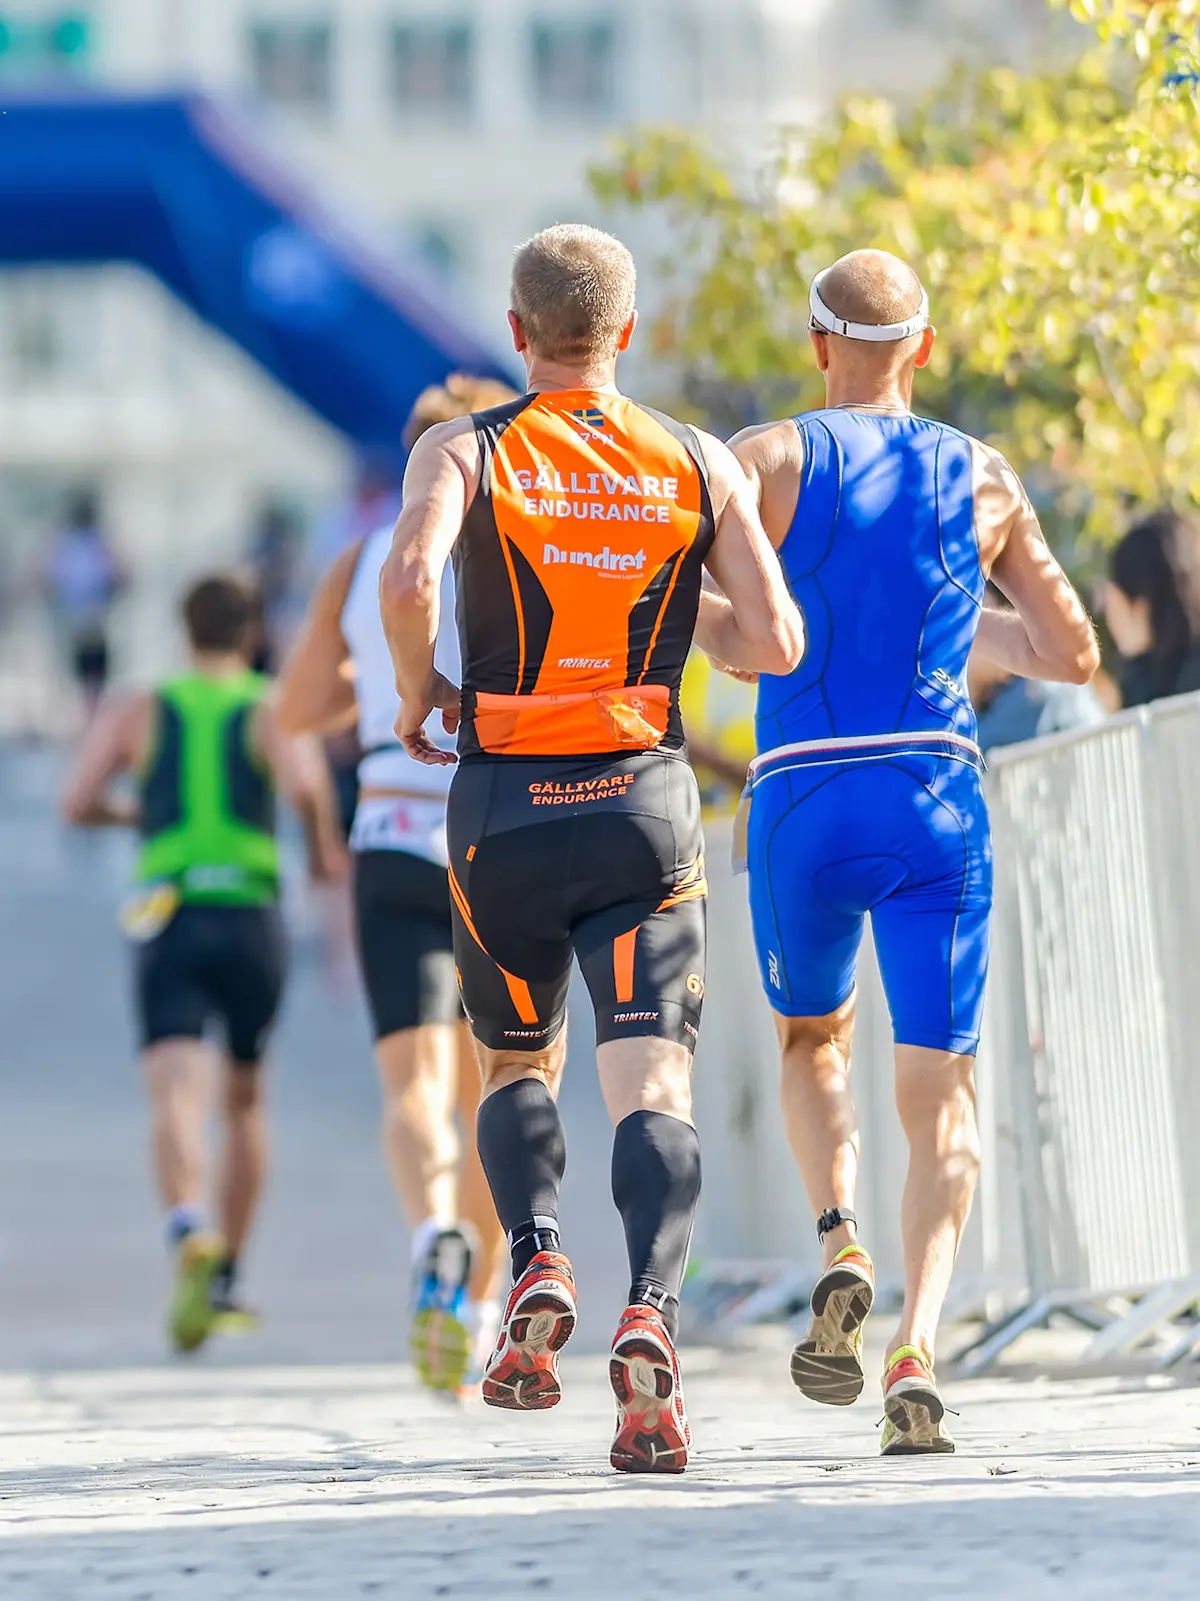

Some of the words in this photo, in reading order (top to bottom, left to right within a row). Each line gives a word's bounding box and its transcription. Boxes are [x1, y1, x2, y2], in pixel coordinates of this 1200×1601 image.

[513, 464, 679, 499] GÄLLIVARE
[524, 498, 670, 523] ENDURANCE
[543, 543, 647, 571] Dundret
[558, 658, 612, 668] TRIMTEX
[528, 773, 635, 794] GÄLLIVARE
[532, 786, 627, 805] ENDURANCE
[613, 1012, 659, 1023] TRIMTEX
